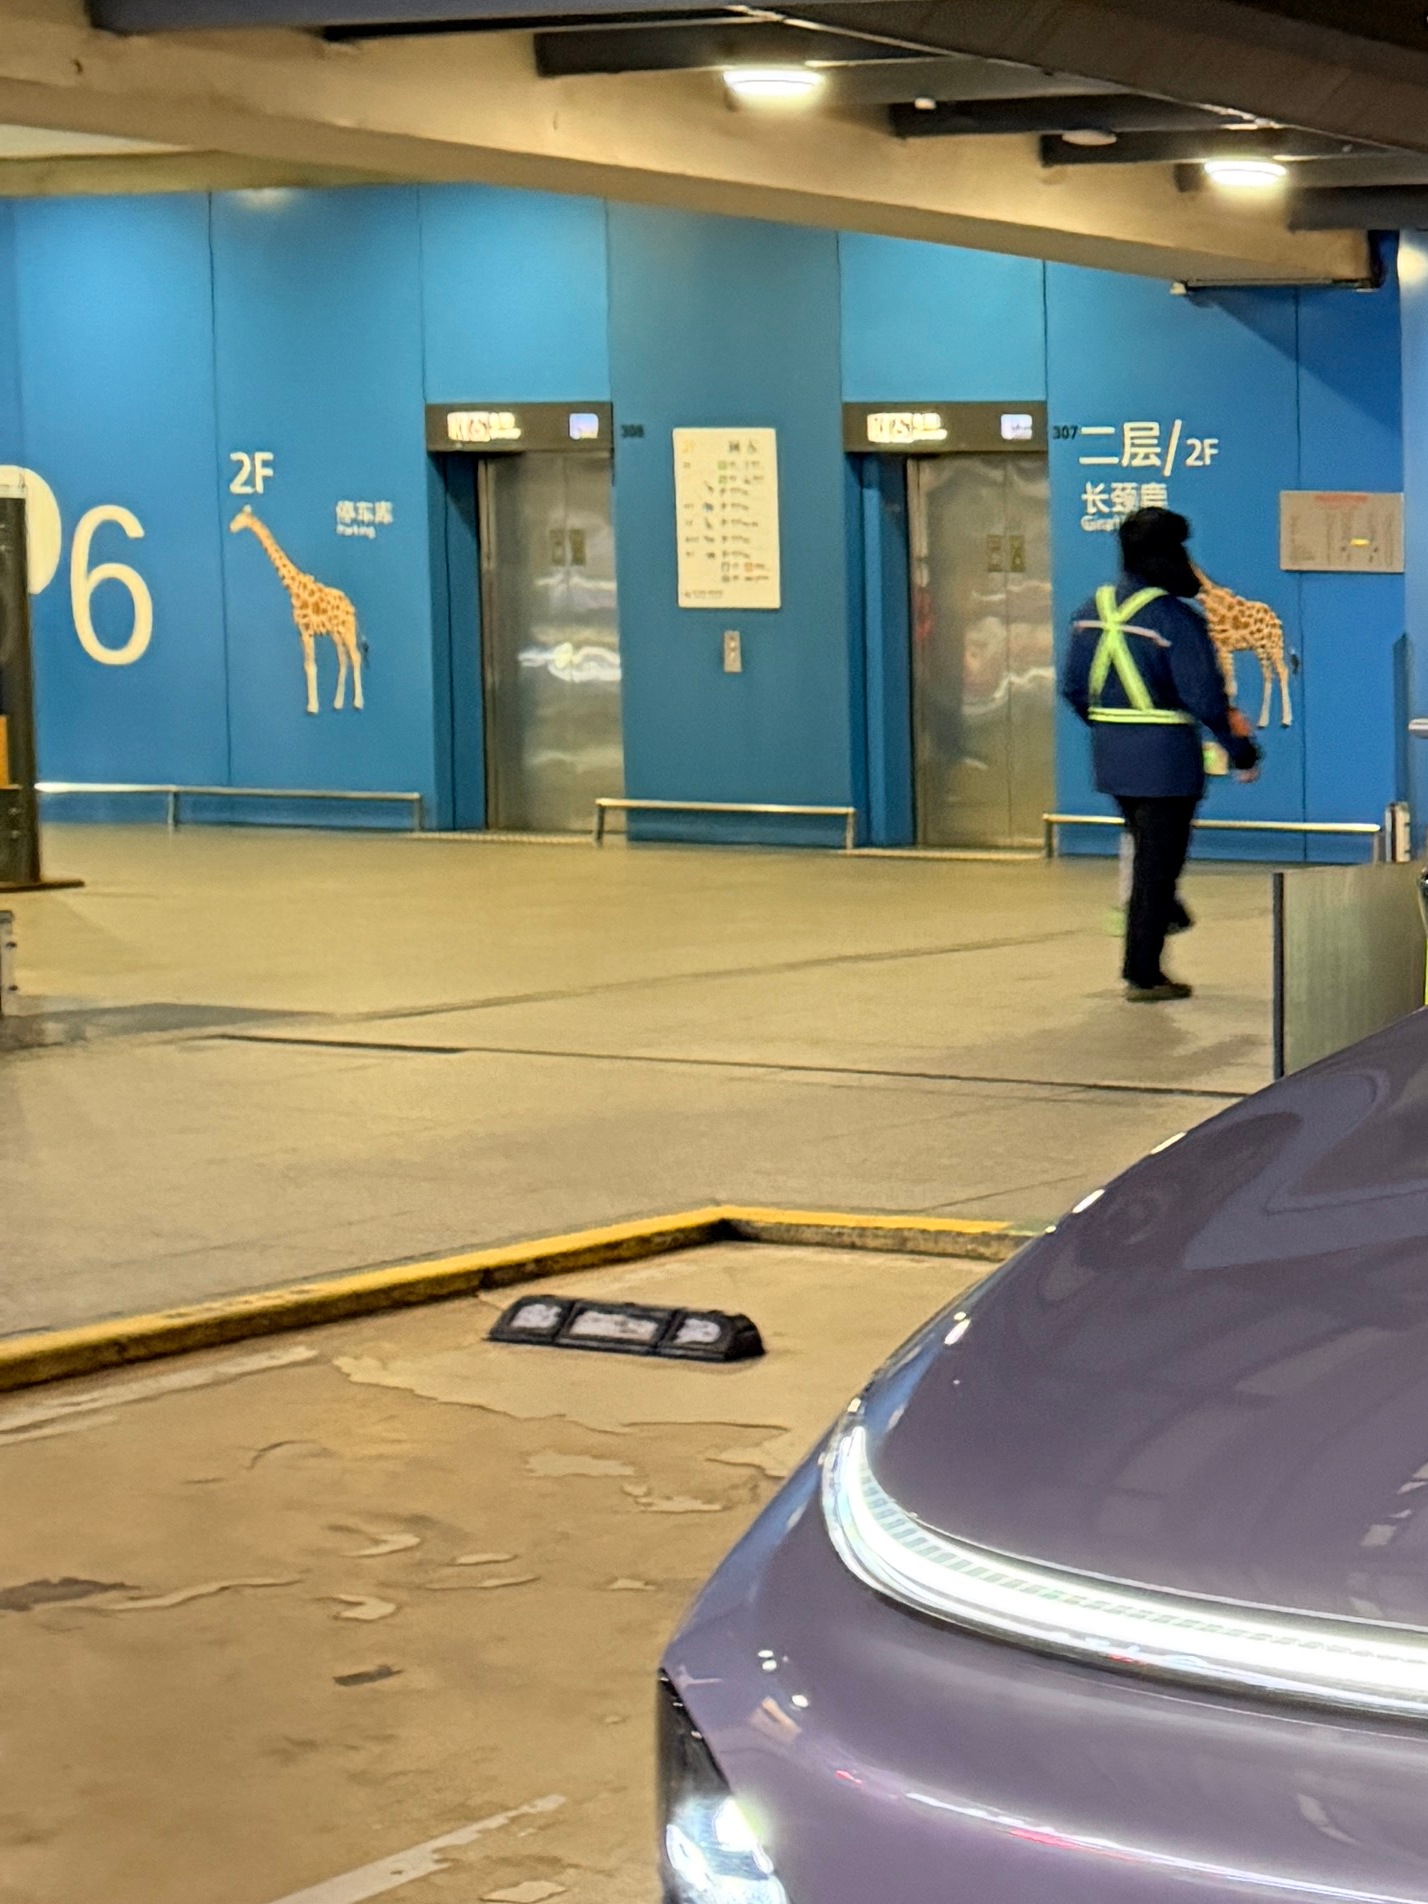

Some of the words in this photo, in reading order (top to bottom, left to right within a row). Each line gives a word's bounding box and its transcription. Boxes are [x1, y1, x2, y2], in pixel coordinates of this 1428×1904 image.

[1052, 424, 1078, 440] 307
[1078, 418, 1220, 477] 二层/2F
[229, 450, 275, 496] 2F
